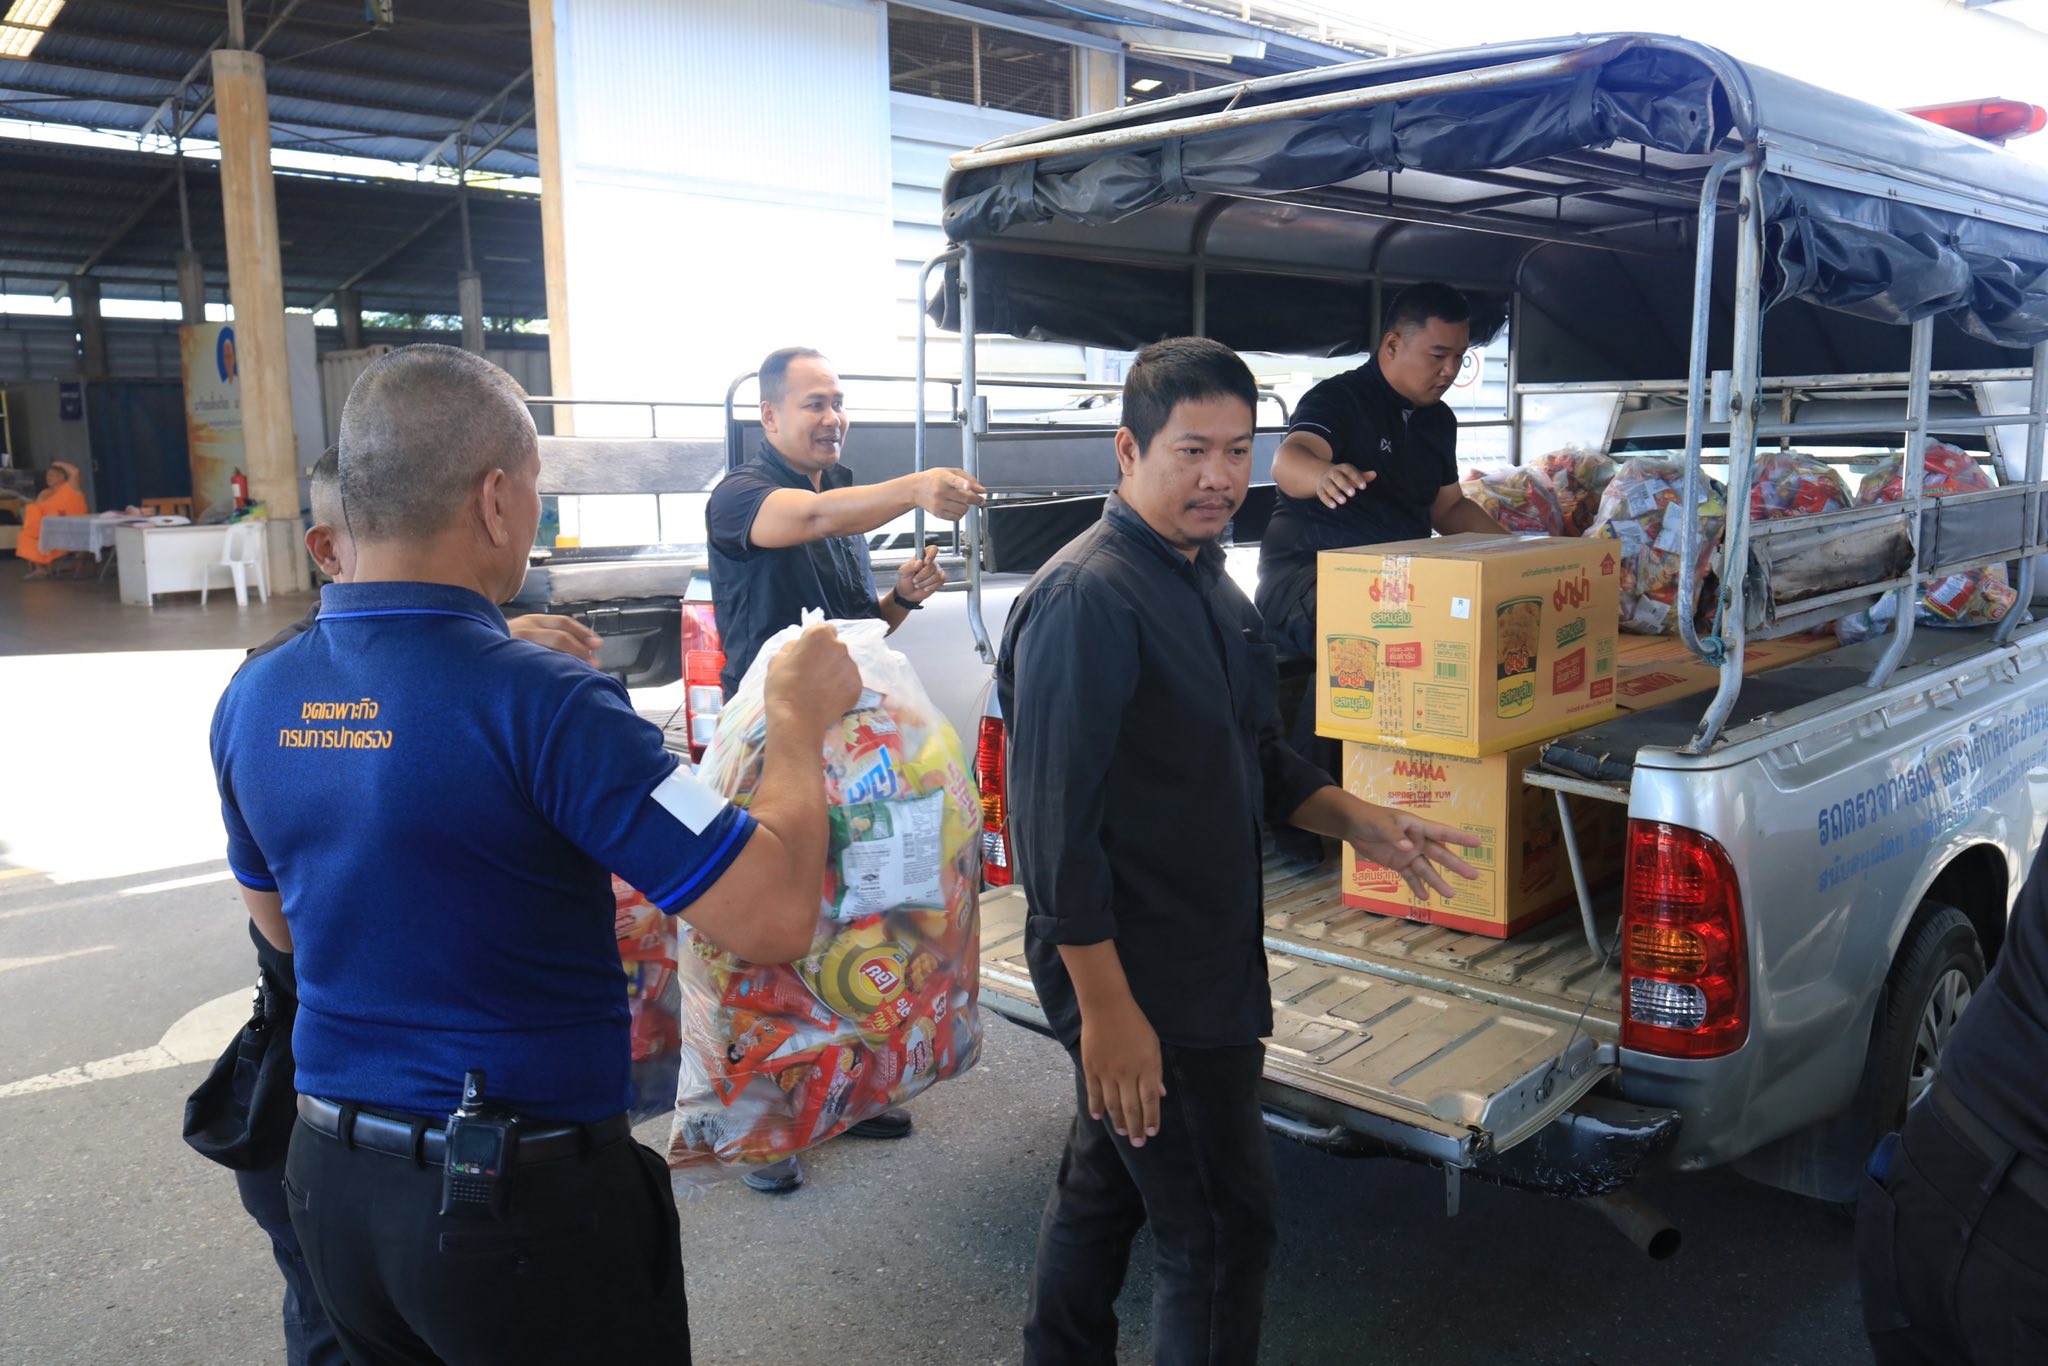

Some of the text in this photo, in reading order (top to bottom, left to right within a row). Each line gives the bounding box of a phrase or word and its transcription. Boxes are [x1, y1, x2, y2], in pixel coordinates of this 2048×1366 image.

[1553, 568, 1590, 612] มาม่า
[1371, 610, 1411, 626] รสหมูสับ
[301, 698, 379, 724] ชุดเฉพาะกิจ
[1334, 696, 1371, 711] รสหมูสับ
[278, 726, 393, 749] กรมการปกครอง
[1392, 760, 1447, 782] MAMA
[1435, 791, 1451, 799] YUM
[1818, 746, 1936, 846] รถตรวจการณ์
